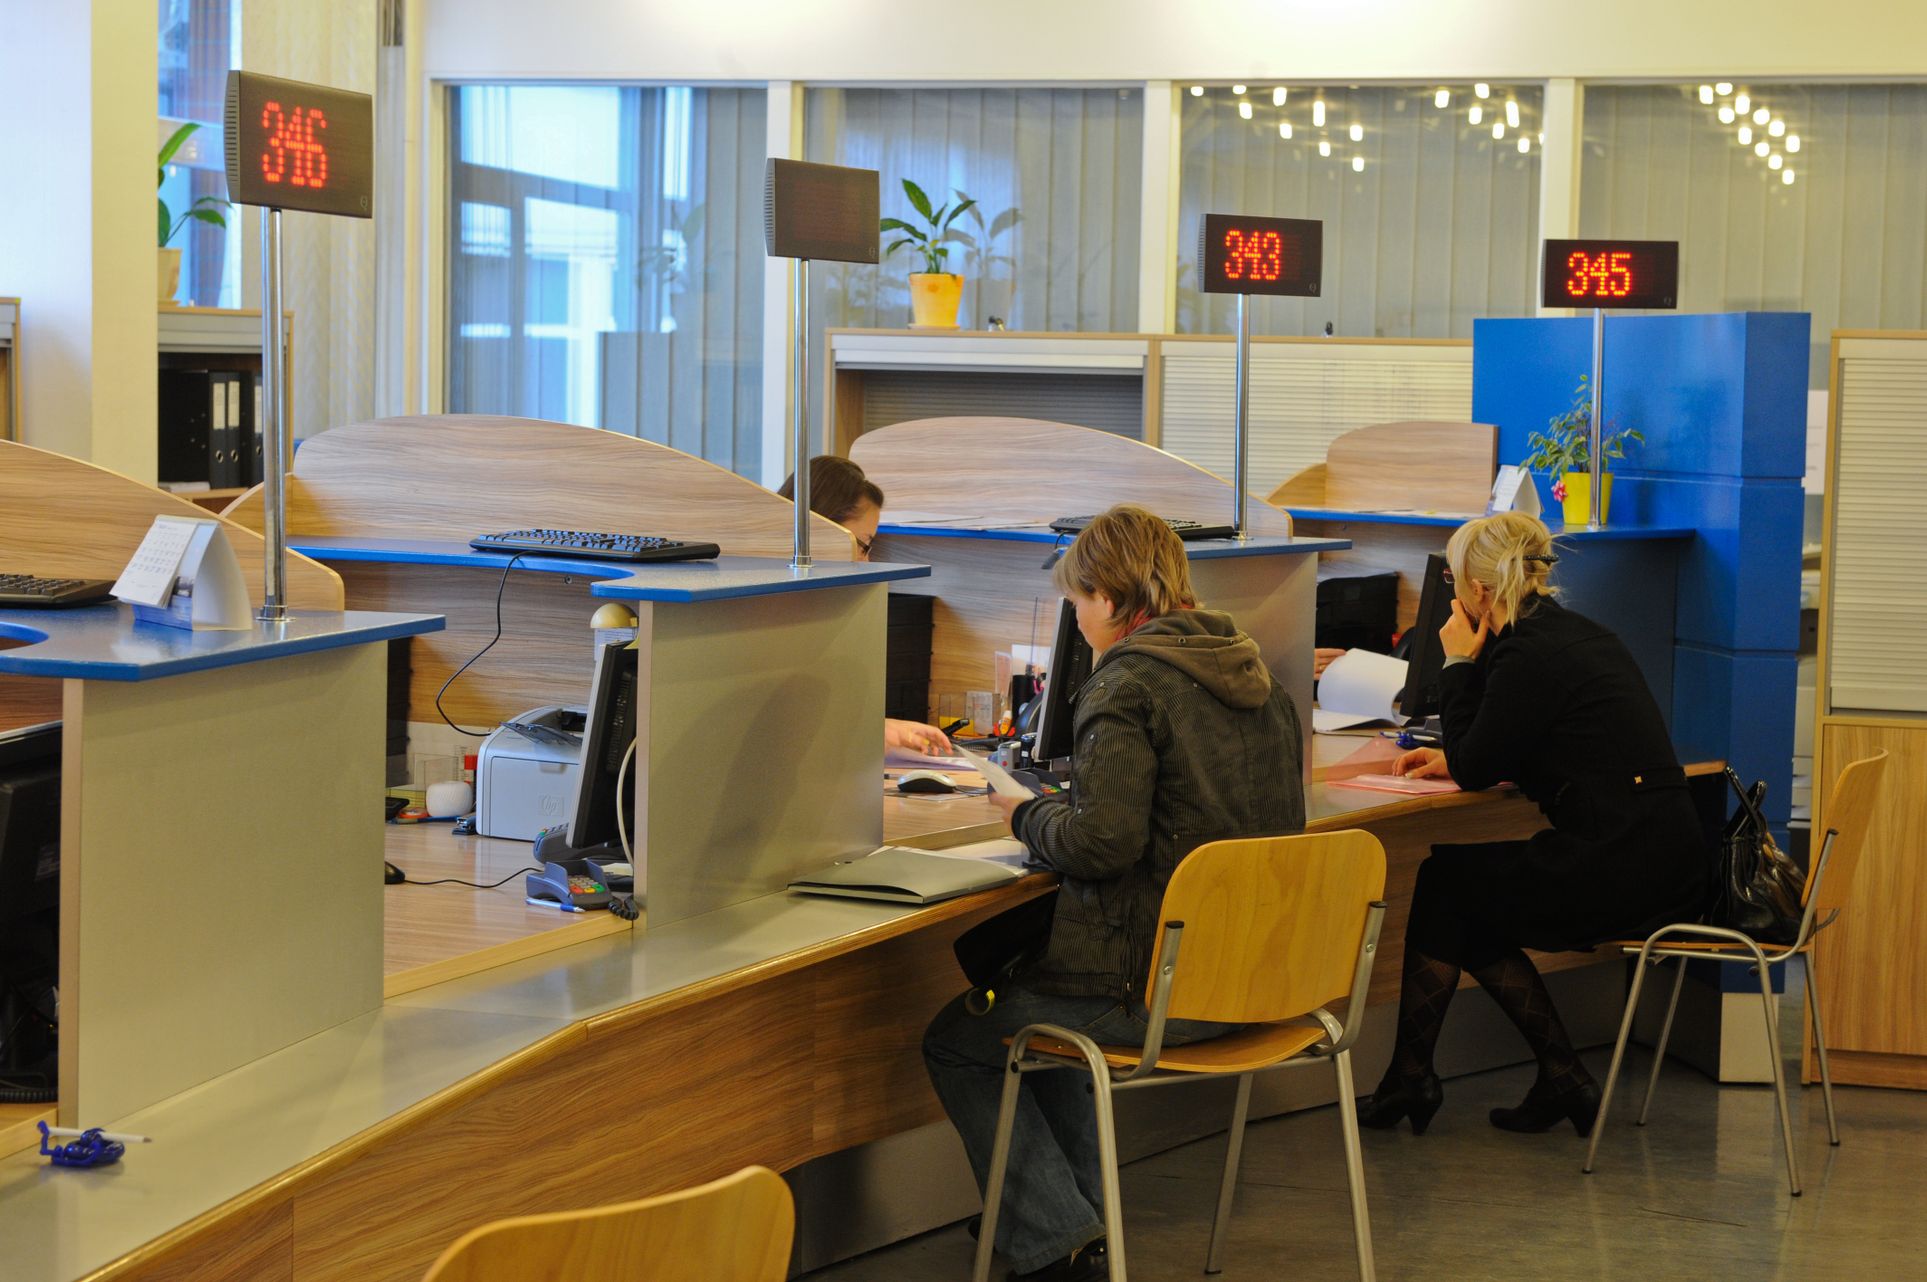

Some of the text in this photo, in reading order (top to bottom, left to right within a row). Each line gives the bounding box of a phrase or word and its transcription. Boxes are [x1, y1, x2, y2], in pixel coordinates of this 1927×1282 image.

[262, 101, 327, 188] 346
[1224, 229, 1280, 280] 343
[1567, 252, 1632, 296] 345
